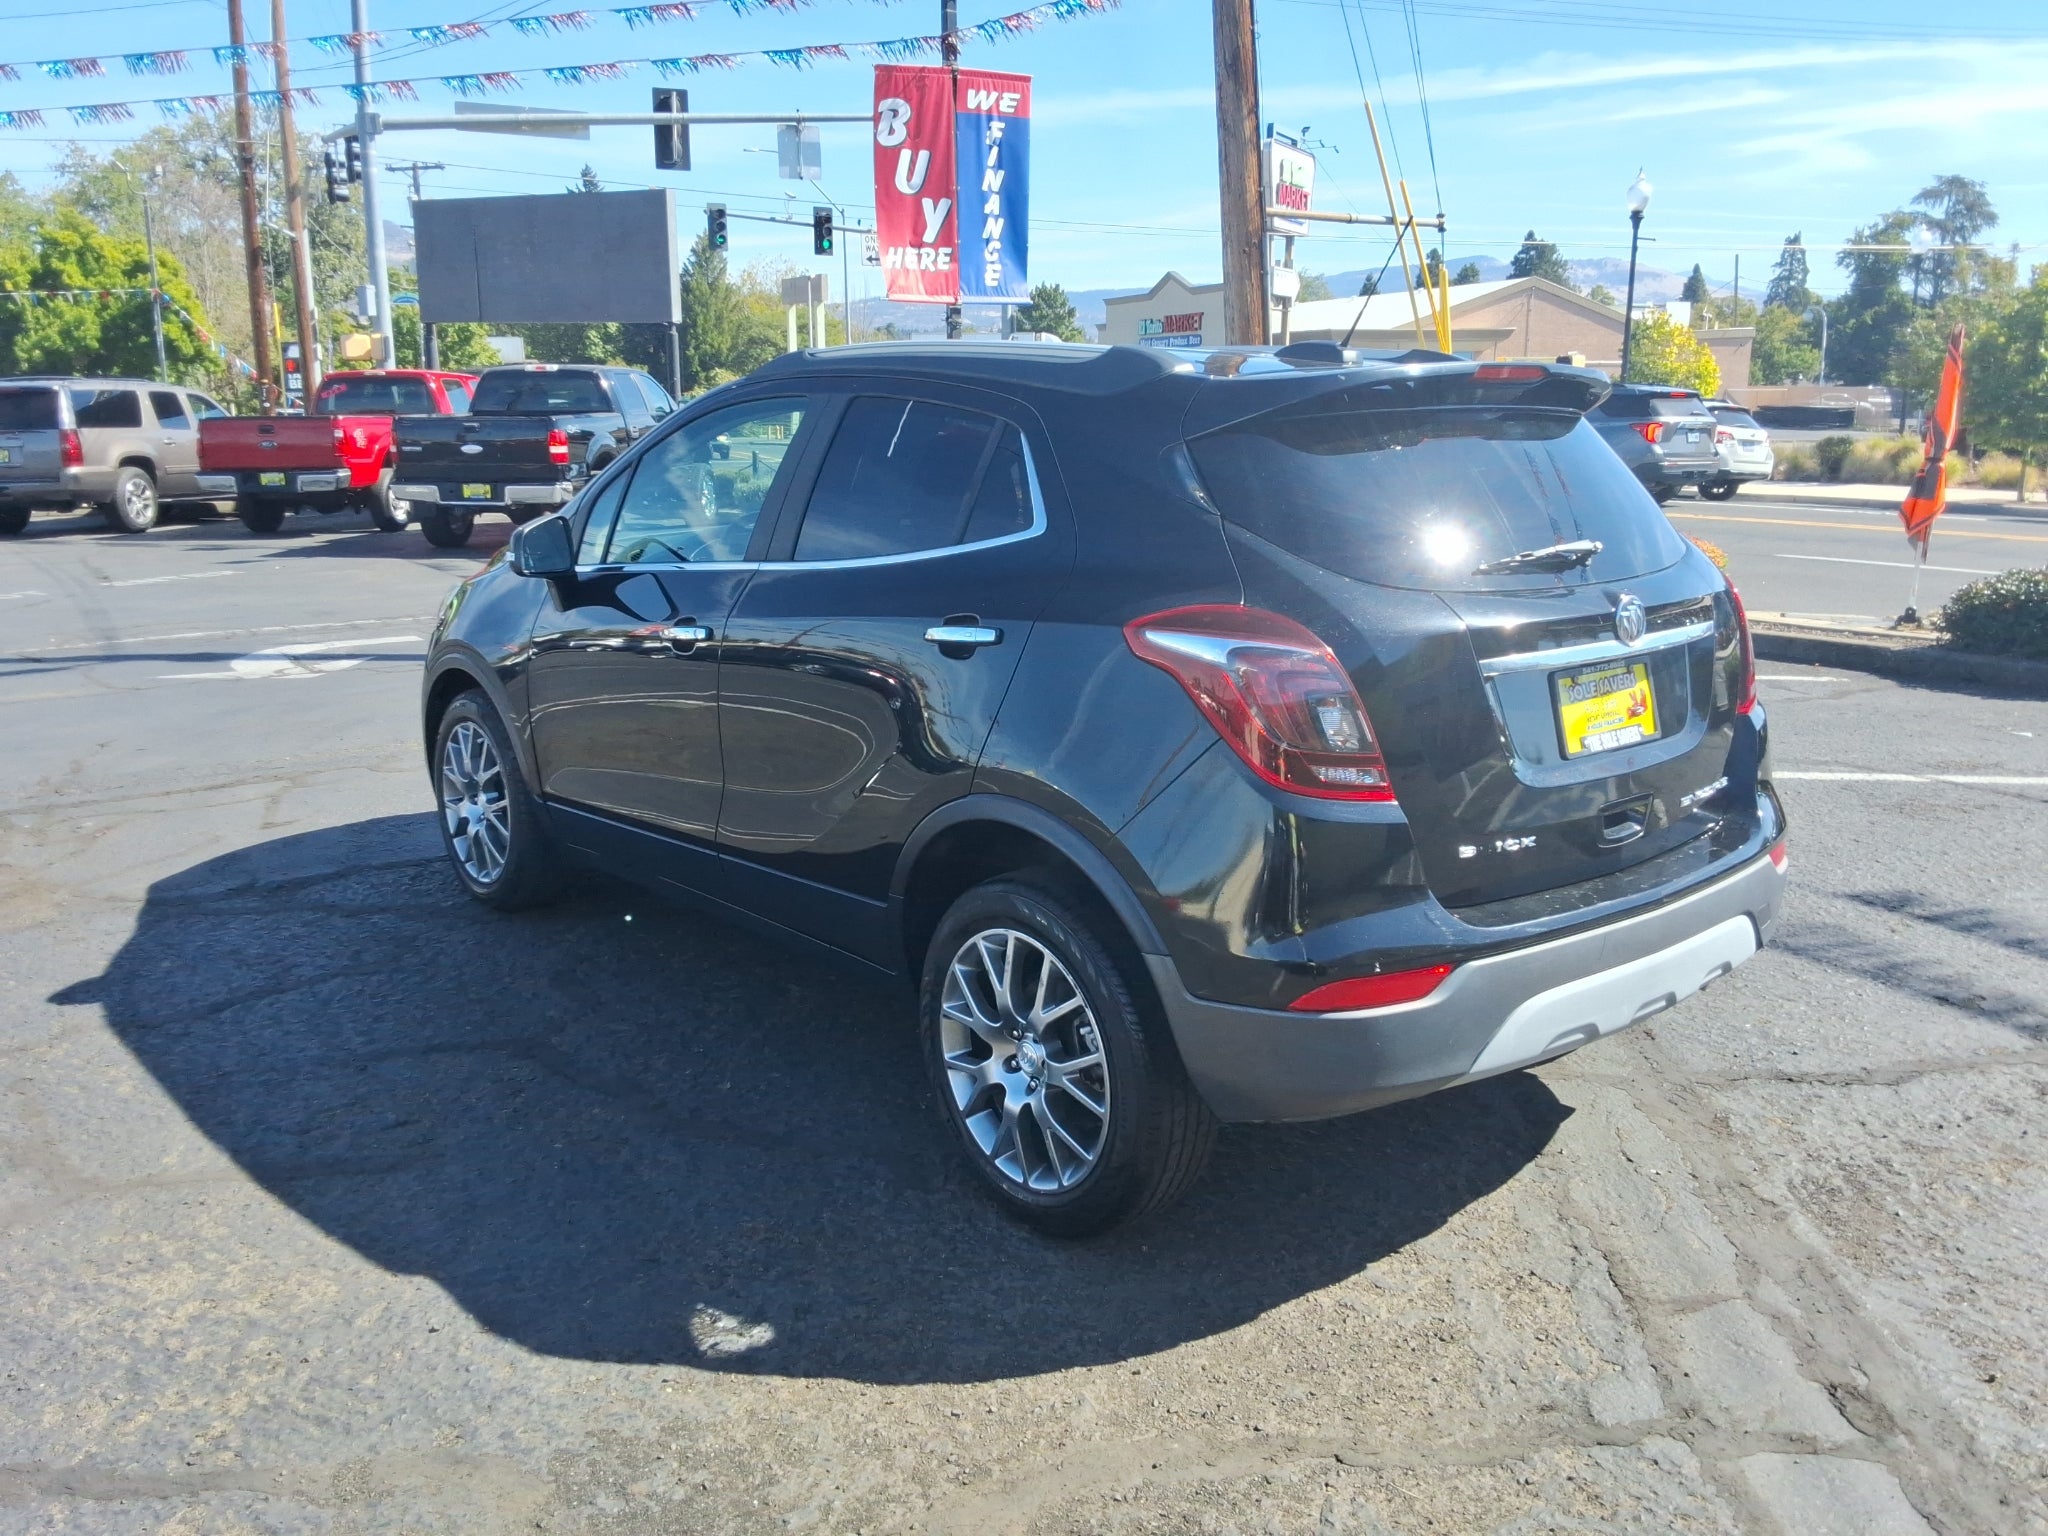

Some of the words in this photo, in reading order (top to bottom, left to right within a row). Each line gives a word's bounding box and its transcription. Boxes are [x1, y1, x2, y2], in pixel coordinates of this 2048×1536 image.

[967, 89, 1020, 113] WE
[876, 98, 952, 244] BUY
[982, 121, 1006, 287] FINANCE
[1277, 183, 1310, 210] MARKET
[886, 246, 952, 272] HERE
[1164, 313, 1203, 333] MARKET
[1599, 673, 1637, 695] SAVERS
